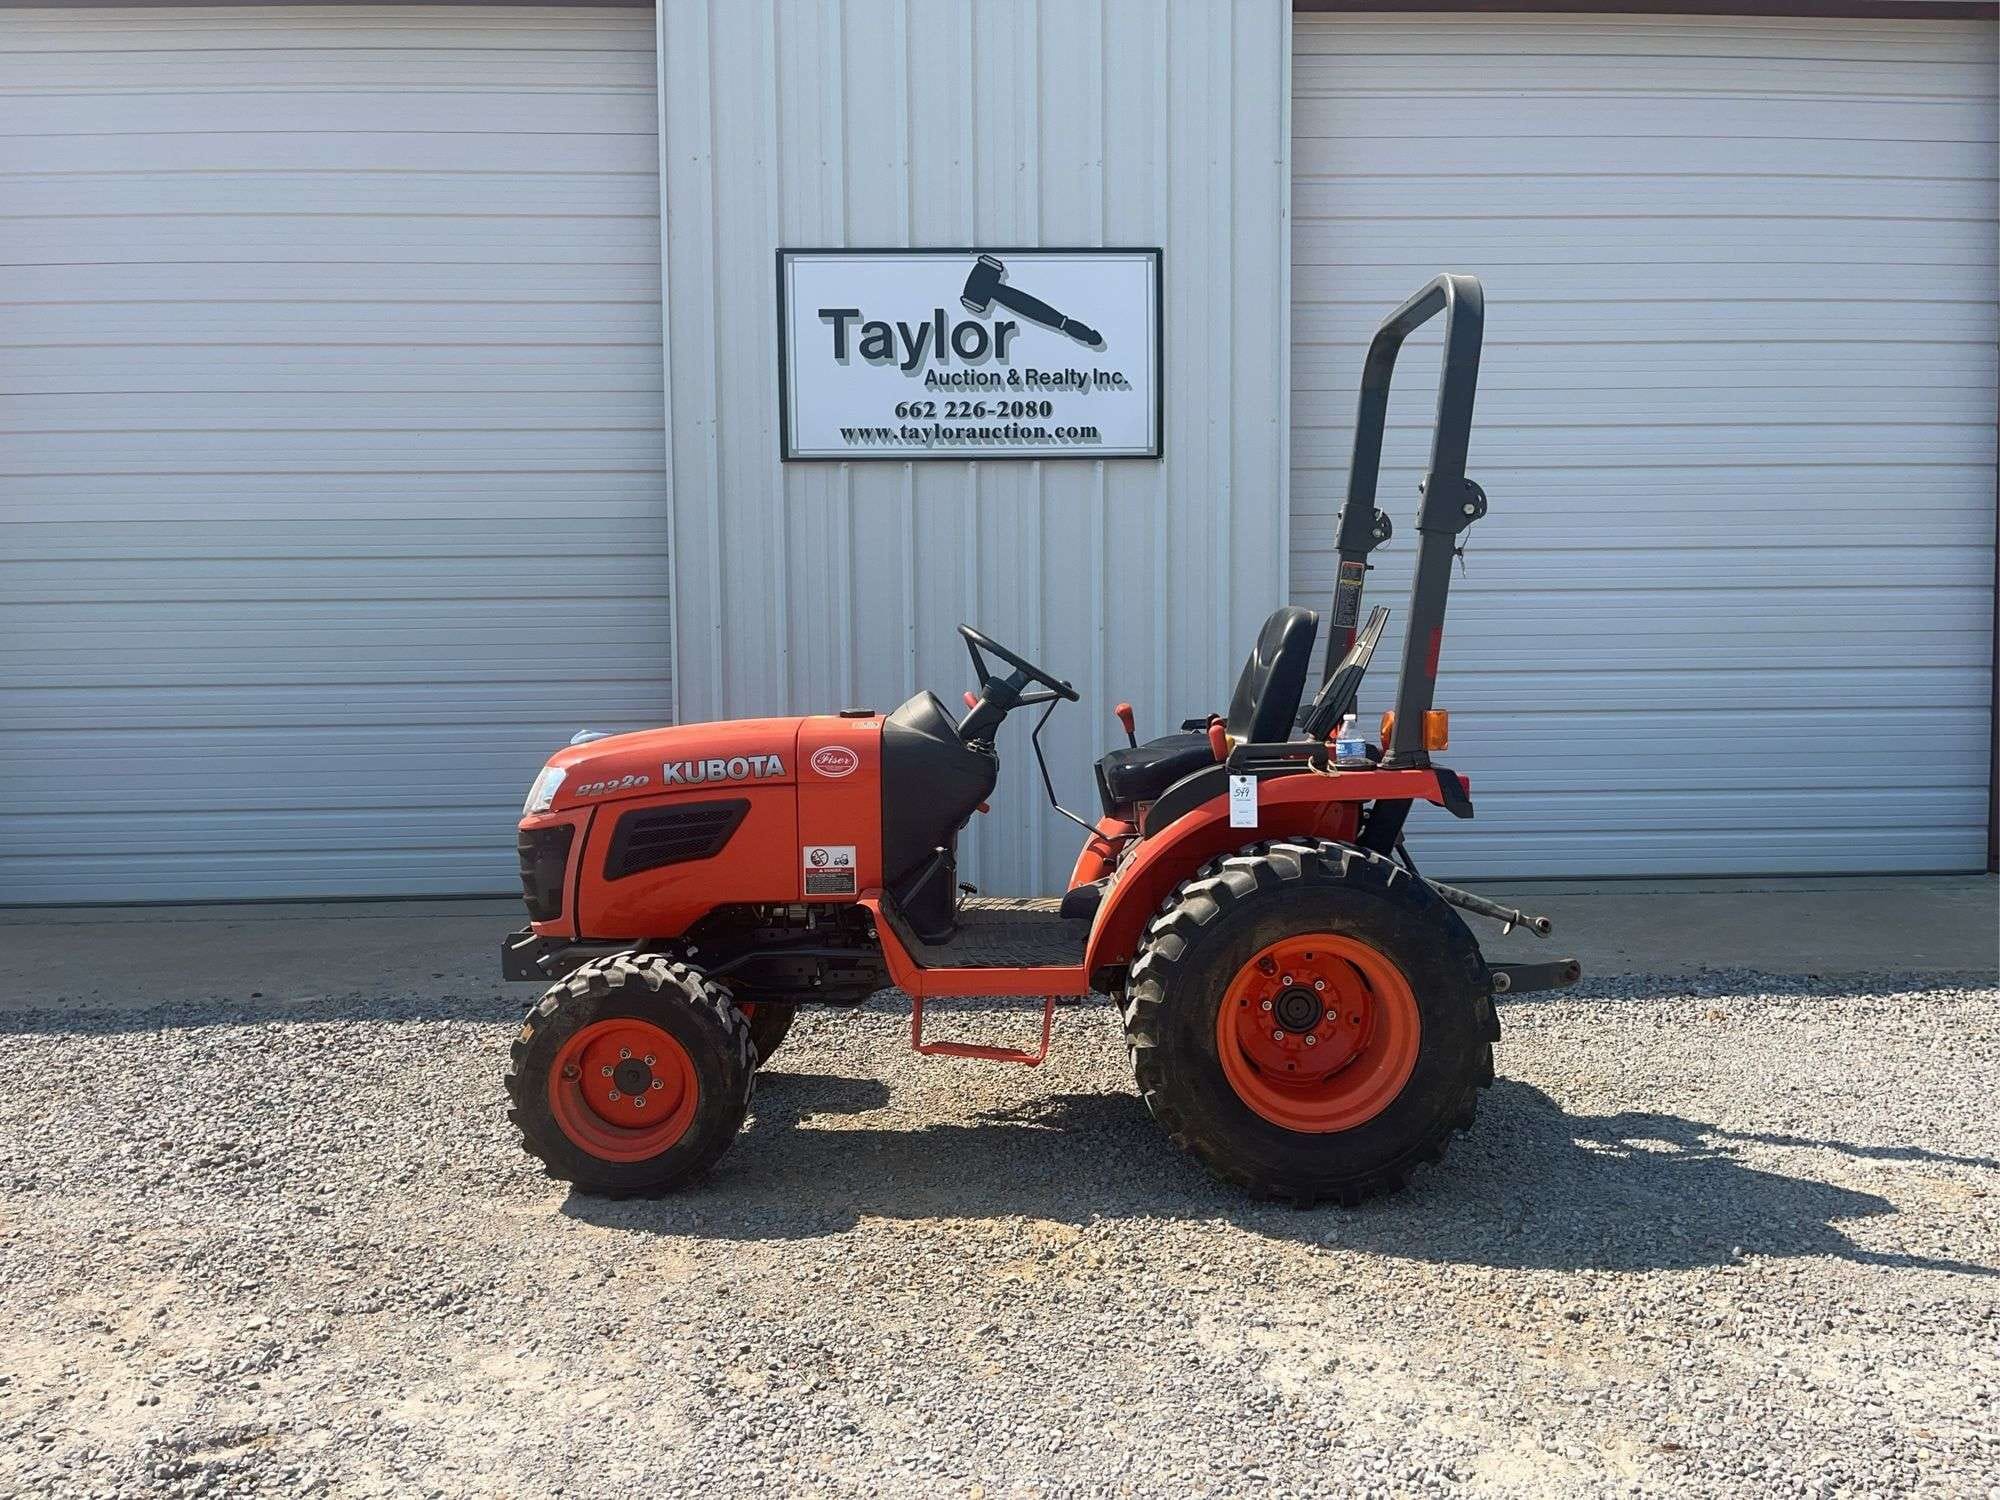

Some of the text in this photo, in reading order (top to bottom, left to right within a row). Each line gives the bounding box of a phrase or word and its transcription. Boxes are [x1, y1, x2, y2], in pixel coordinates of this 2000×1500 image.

[817, 307, 1017, 372] Taylor
[924, 367, 1129, 389] Auction & Realty Inc.
[895, 399, 1054, 419] 662 226-2080
[839, 422, 1099, 443] www.taylorauction.com
[662, 754, 786, 785] KUBOTA
